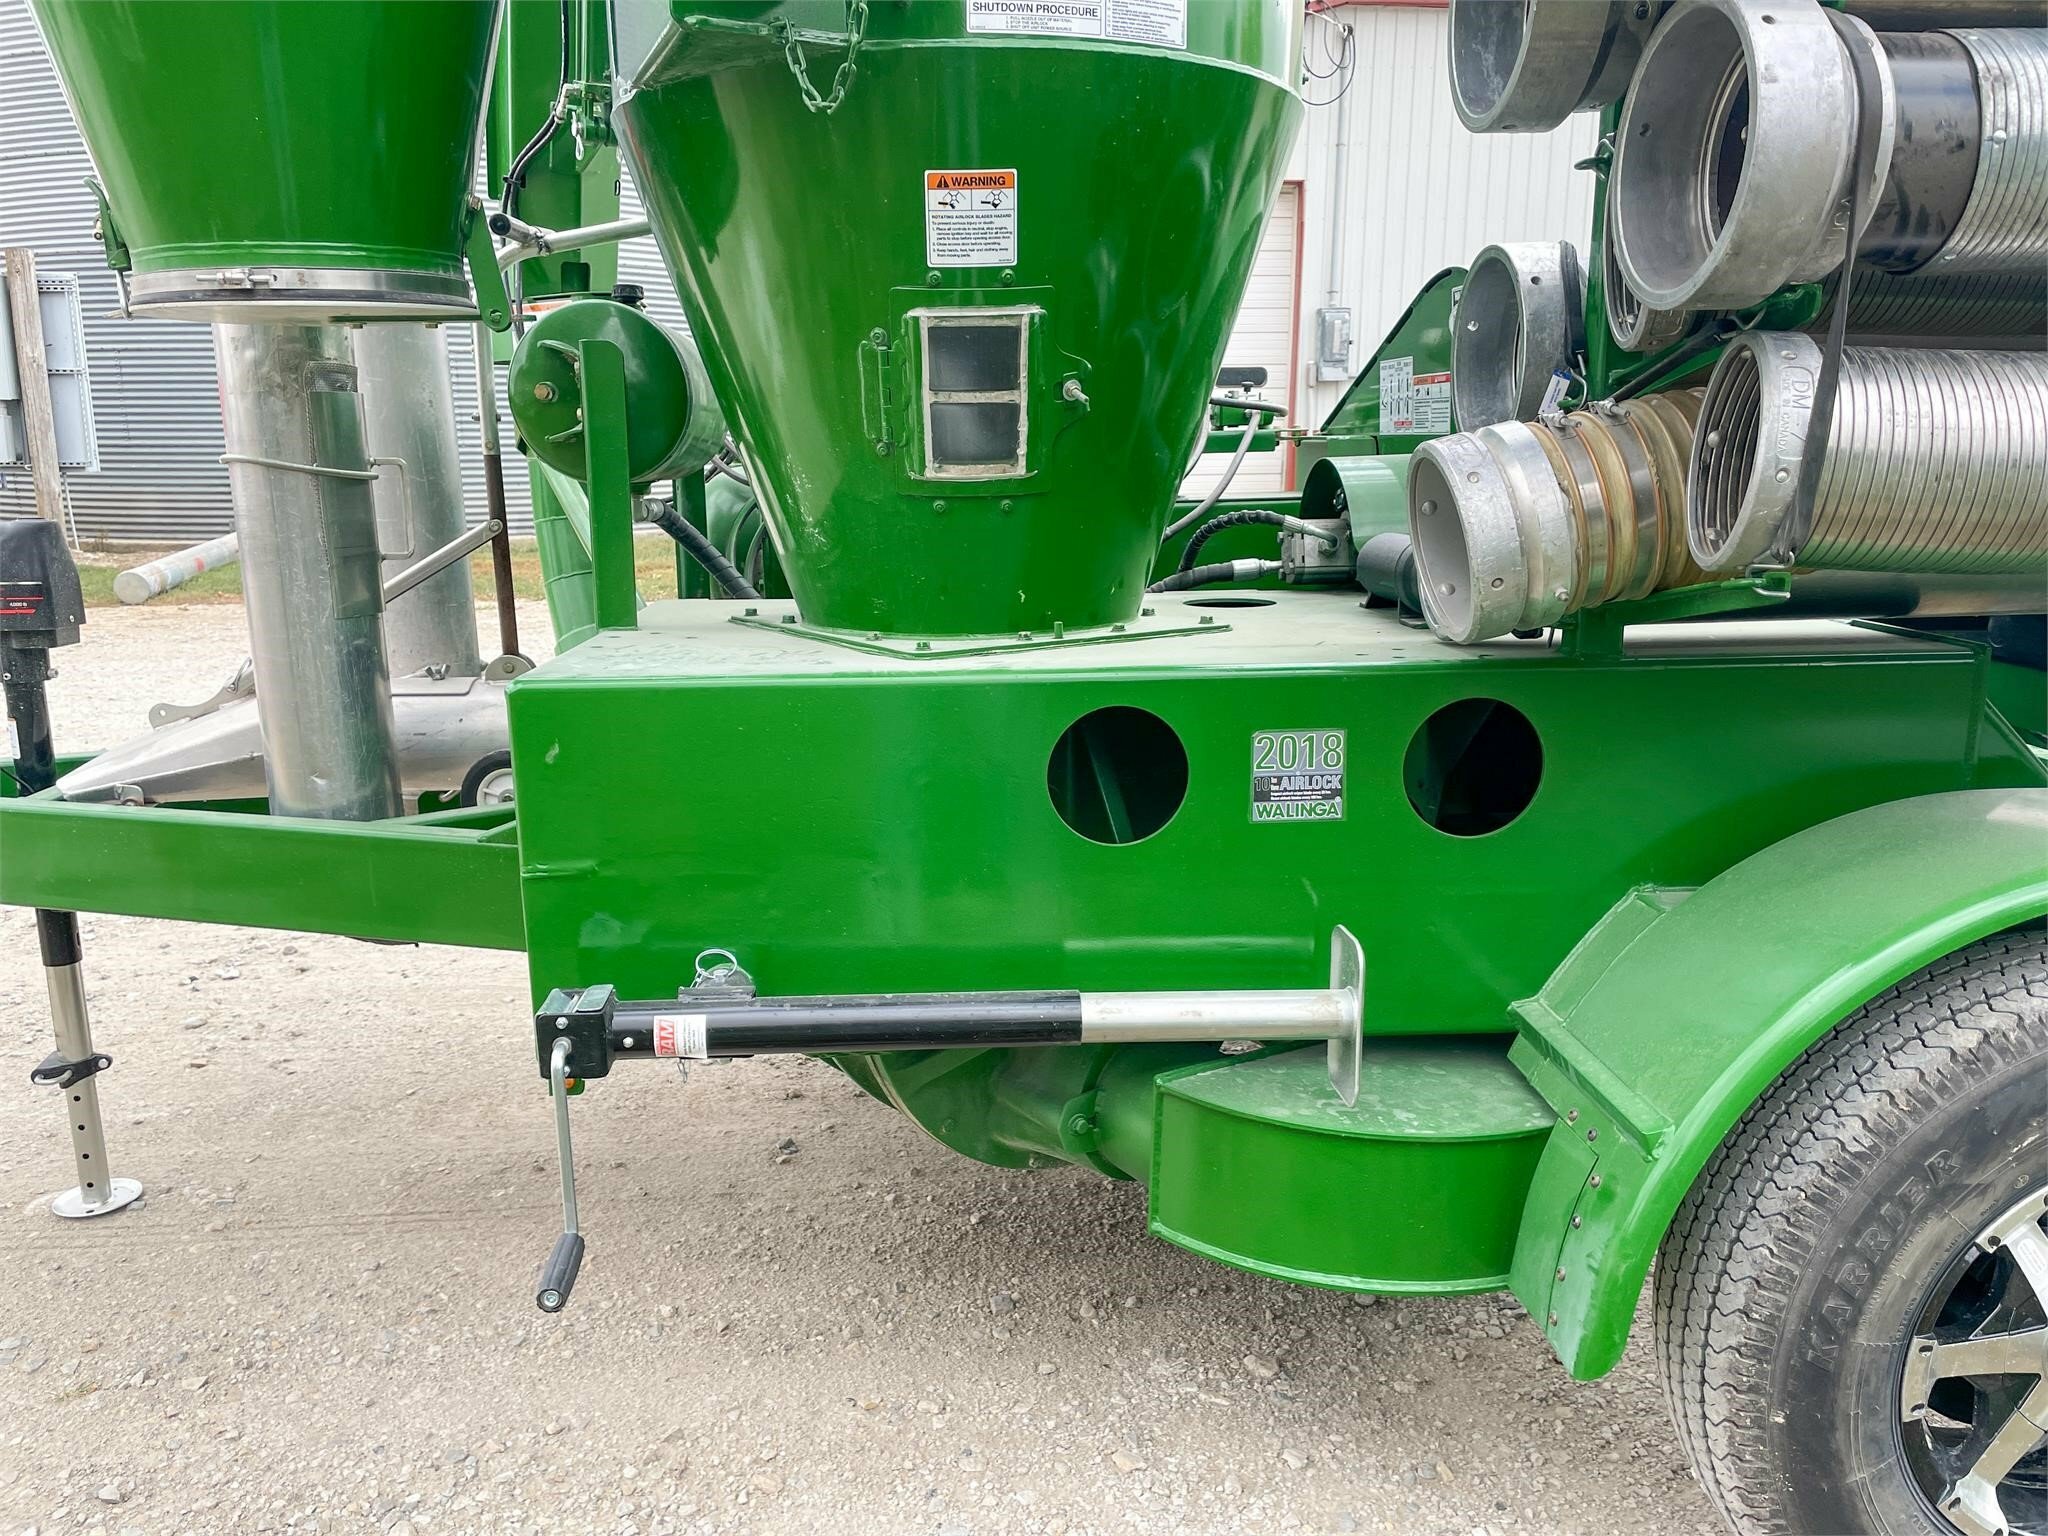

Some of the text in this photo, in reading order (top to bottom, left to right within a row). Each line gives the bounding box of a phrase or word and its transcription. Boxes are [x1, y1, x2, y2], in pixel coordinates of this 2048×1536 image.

[972, 2, 1099, 17] SHUTDOWN PROCEDURE
[951, 176, 1006, 187] WARNING
[1254, 733, 1344, 771] 2018
[1255, 777, 1271, 791] 10
[1280, 774, 1342, 791] AIRLOCK
[1255, 801, 1341, 819] WALINGA
[660, 1021, 675, 1056] RAM
[1806, 1149, 1961, 1373] KARRIER
